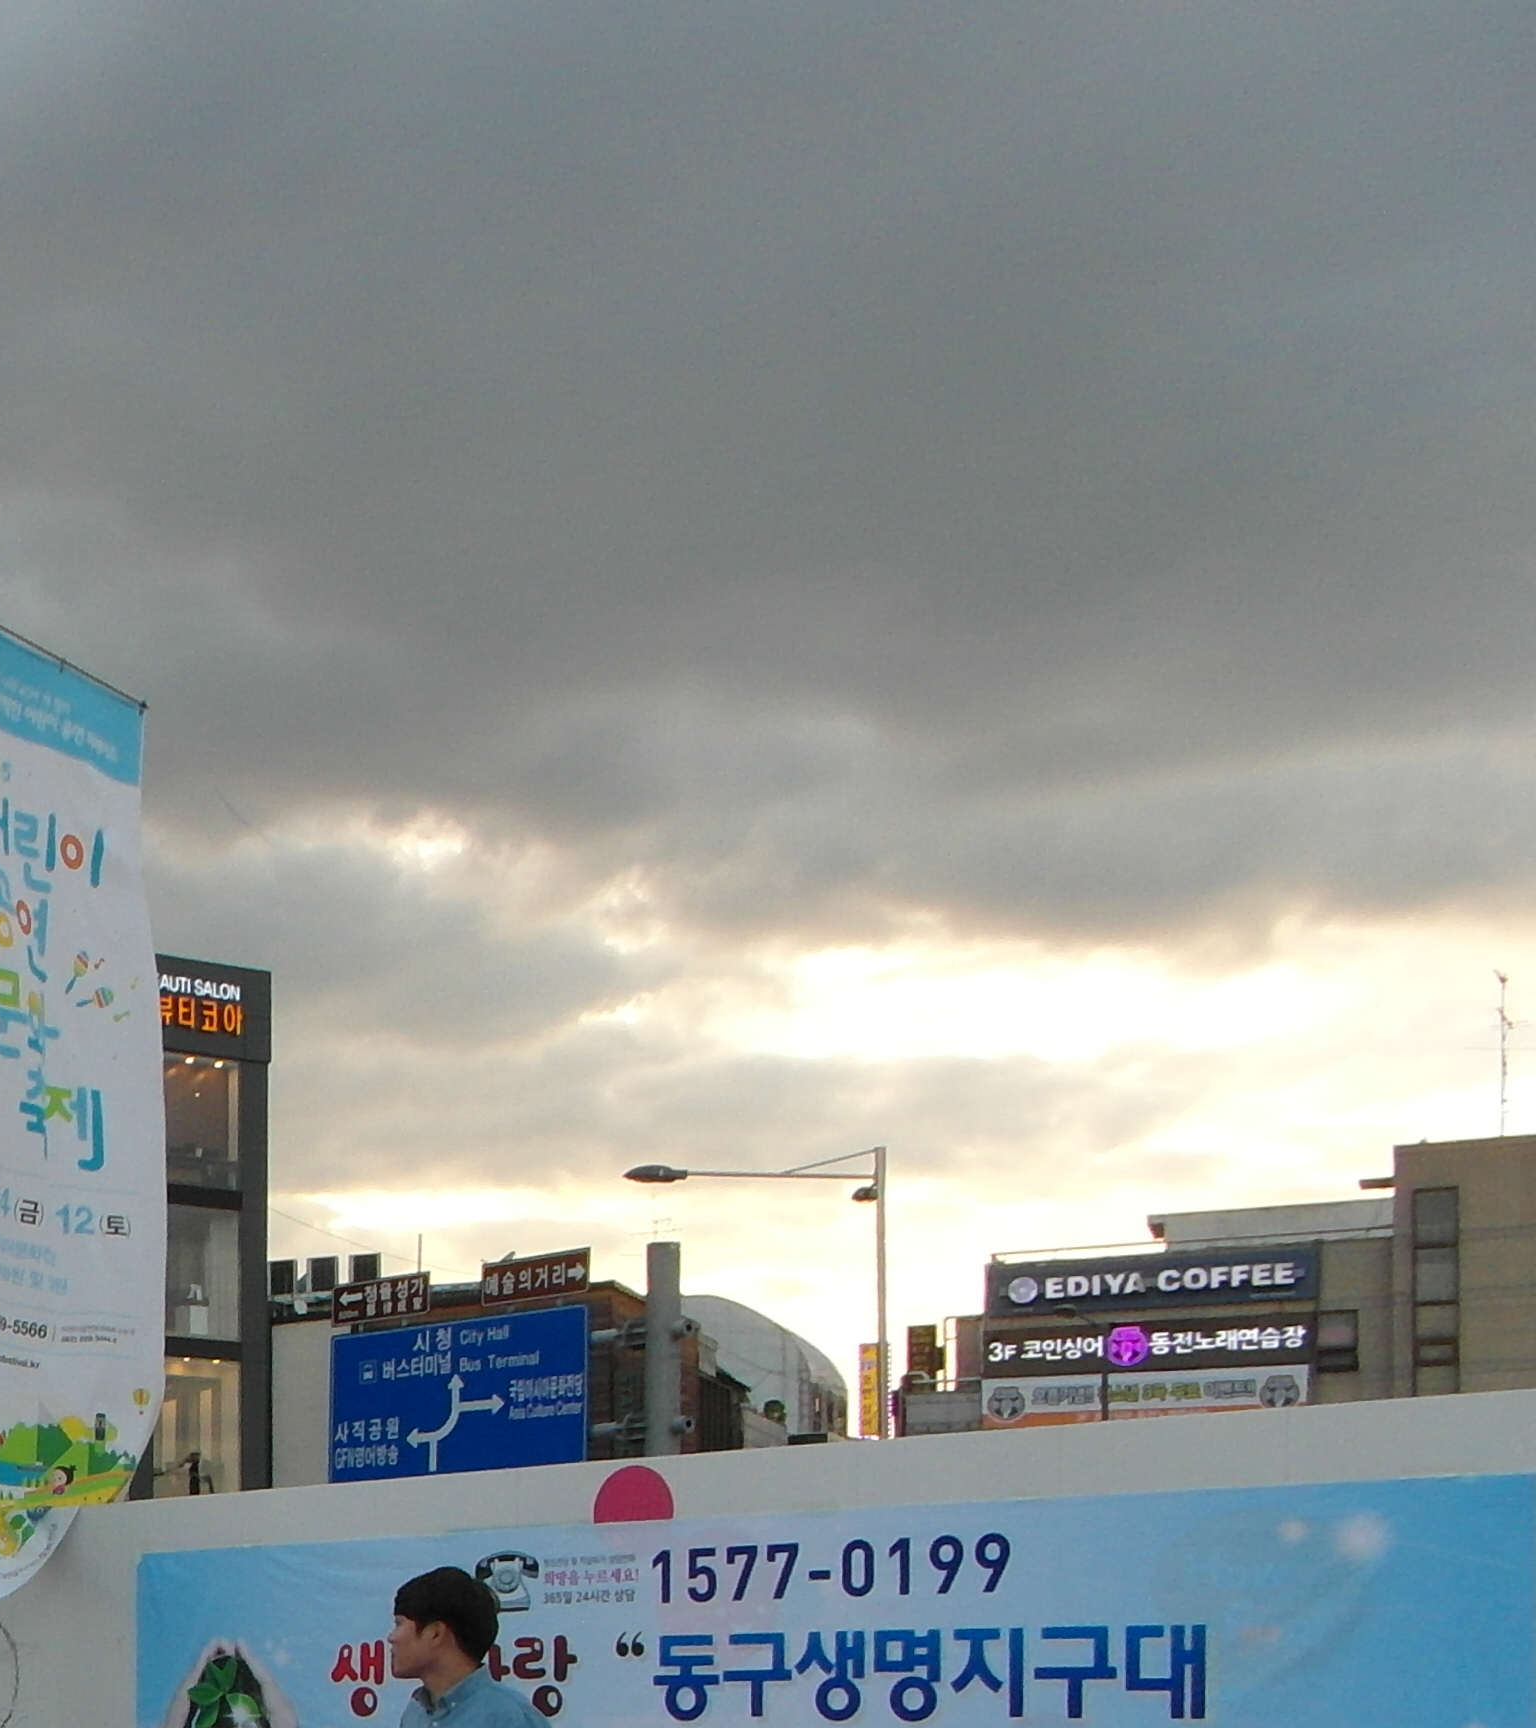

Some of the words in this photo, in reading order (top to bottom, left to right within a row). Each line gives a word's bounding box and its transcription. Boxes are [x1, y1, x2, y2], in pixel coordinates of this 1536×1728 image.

[194, 978, 241, 1002] SALON
[484, 1264, 567, 1297] 예술의거리
[1044, 1271, 1146, 1300] EDIYA
[1156, 1261, 1297, 1293] COFFEE
[413, 1327, 453, 1353] 시청
[459, 1329, 484, 1348] City
[487, 1325, 510, 1342] Hall
[987, 1340, 1017, 1363] 3F
[1020, 1335, 1105, 1361] 코인싱어
[1148, 1325, 1308, 1356] 동전노래연습장
[381, 1351, 452, 1381] 버스터미널
[459, 1357, 482, 1373] Bus
[487, 1350, 540, 1370] Terminal
[334, 1416, 400, 1445] 사직공원
[651, 1532, 1012, 1605] 1577-0199
[575, 1589, 612, 1603] 24시간
[614, 1587, 636, 1603] 상담
[330, 1634, 580, 1718] 생랑
